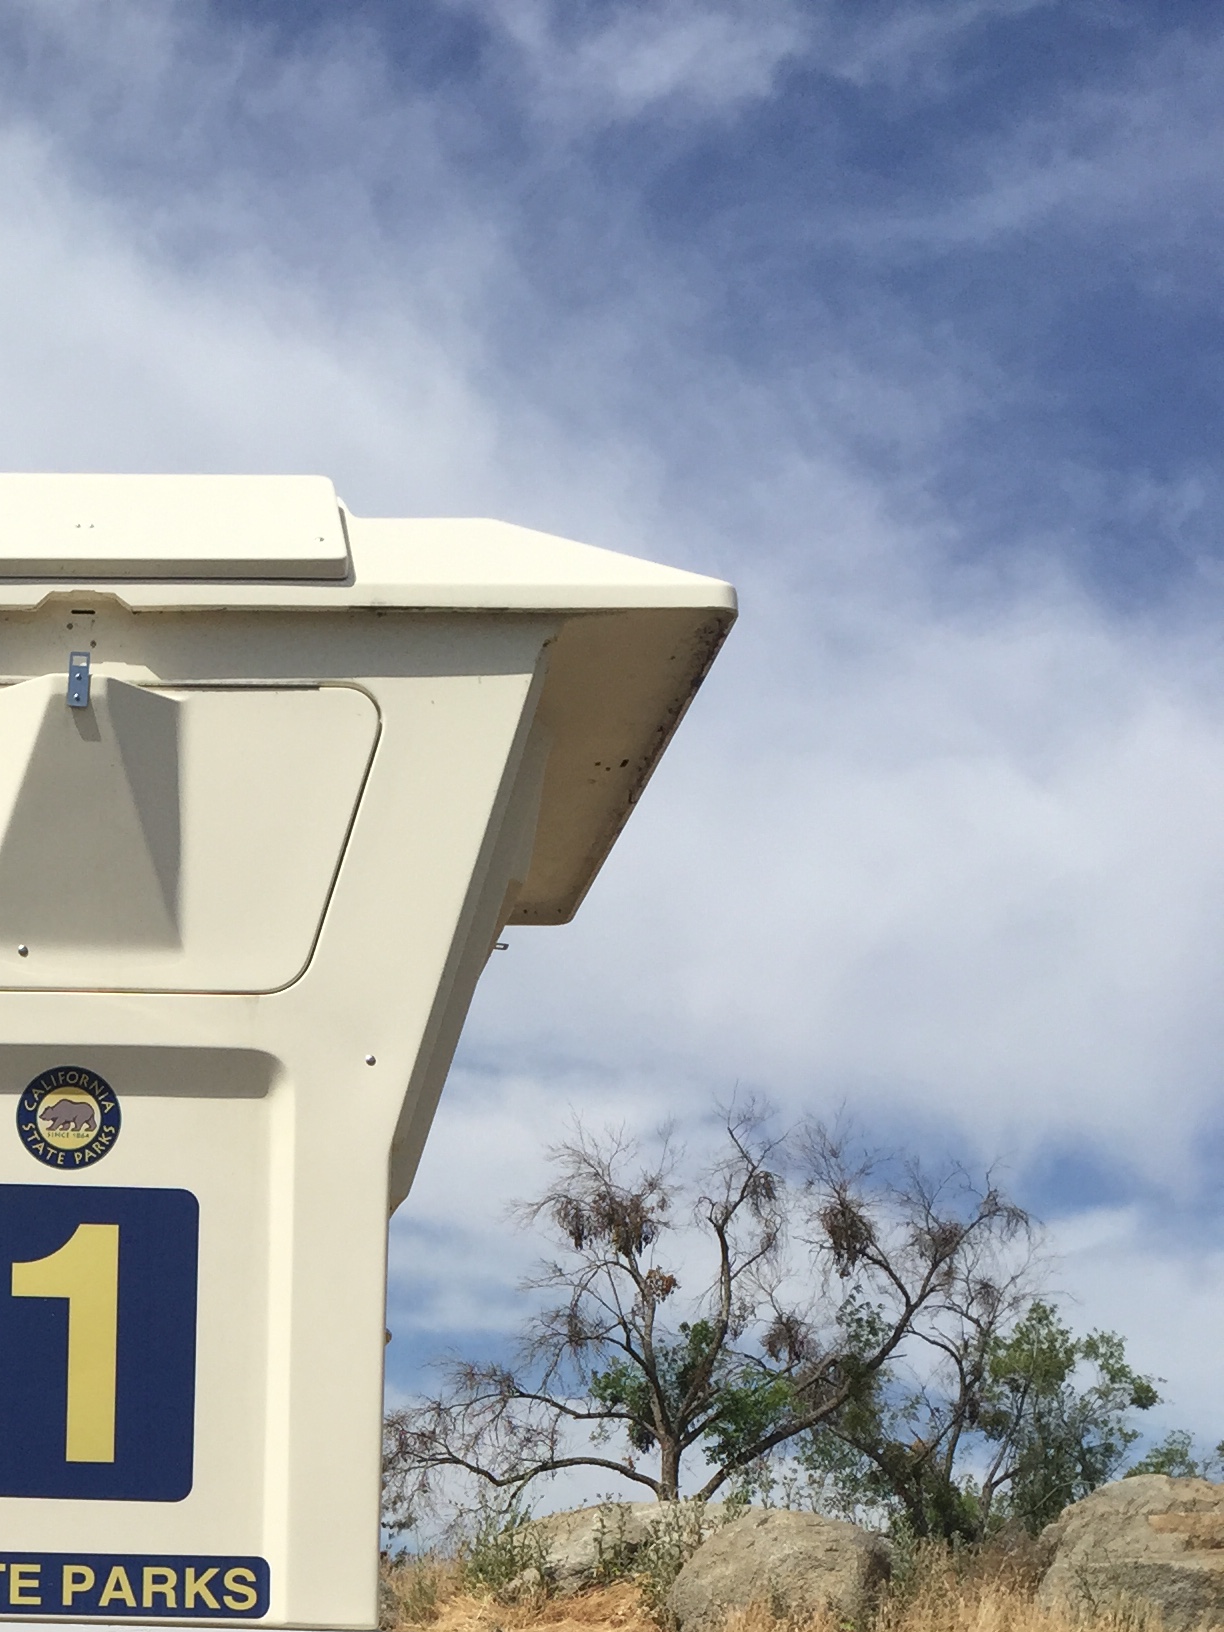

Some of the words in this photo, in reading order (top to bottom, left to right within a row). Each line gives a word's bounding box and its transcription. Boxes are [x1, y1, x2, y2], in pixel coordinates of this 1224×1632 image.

[24, 1071, 115, 1113] CALIFORNIA
[22, 1123, 66, 1165] STATE
[74, 1125, 116, 1165] PARKS
[12, 1223, 120, 1463] 1
[62, 1564, 258, 1611] PARKS
